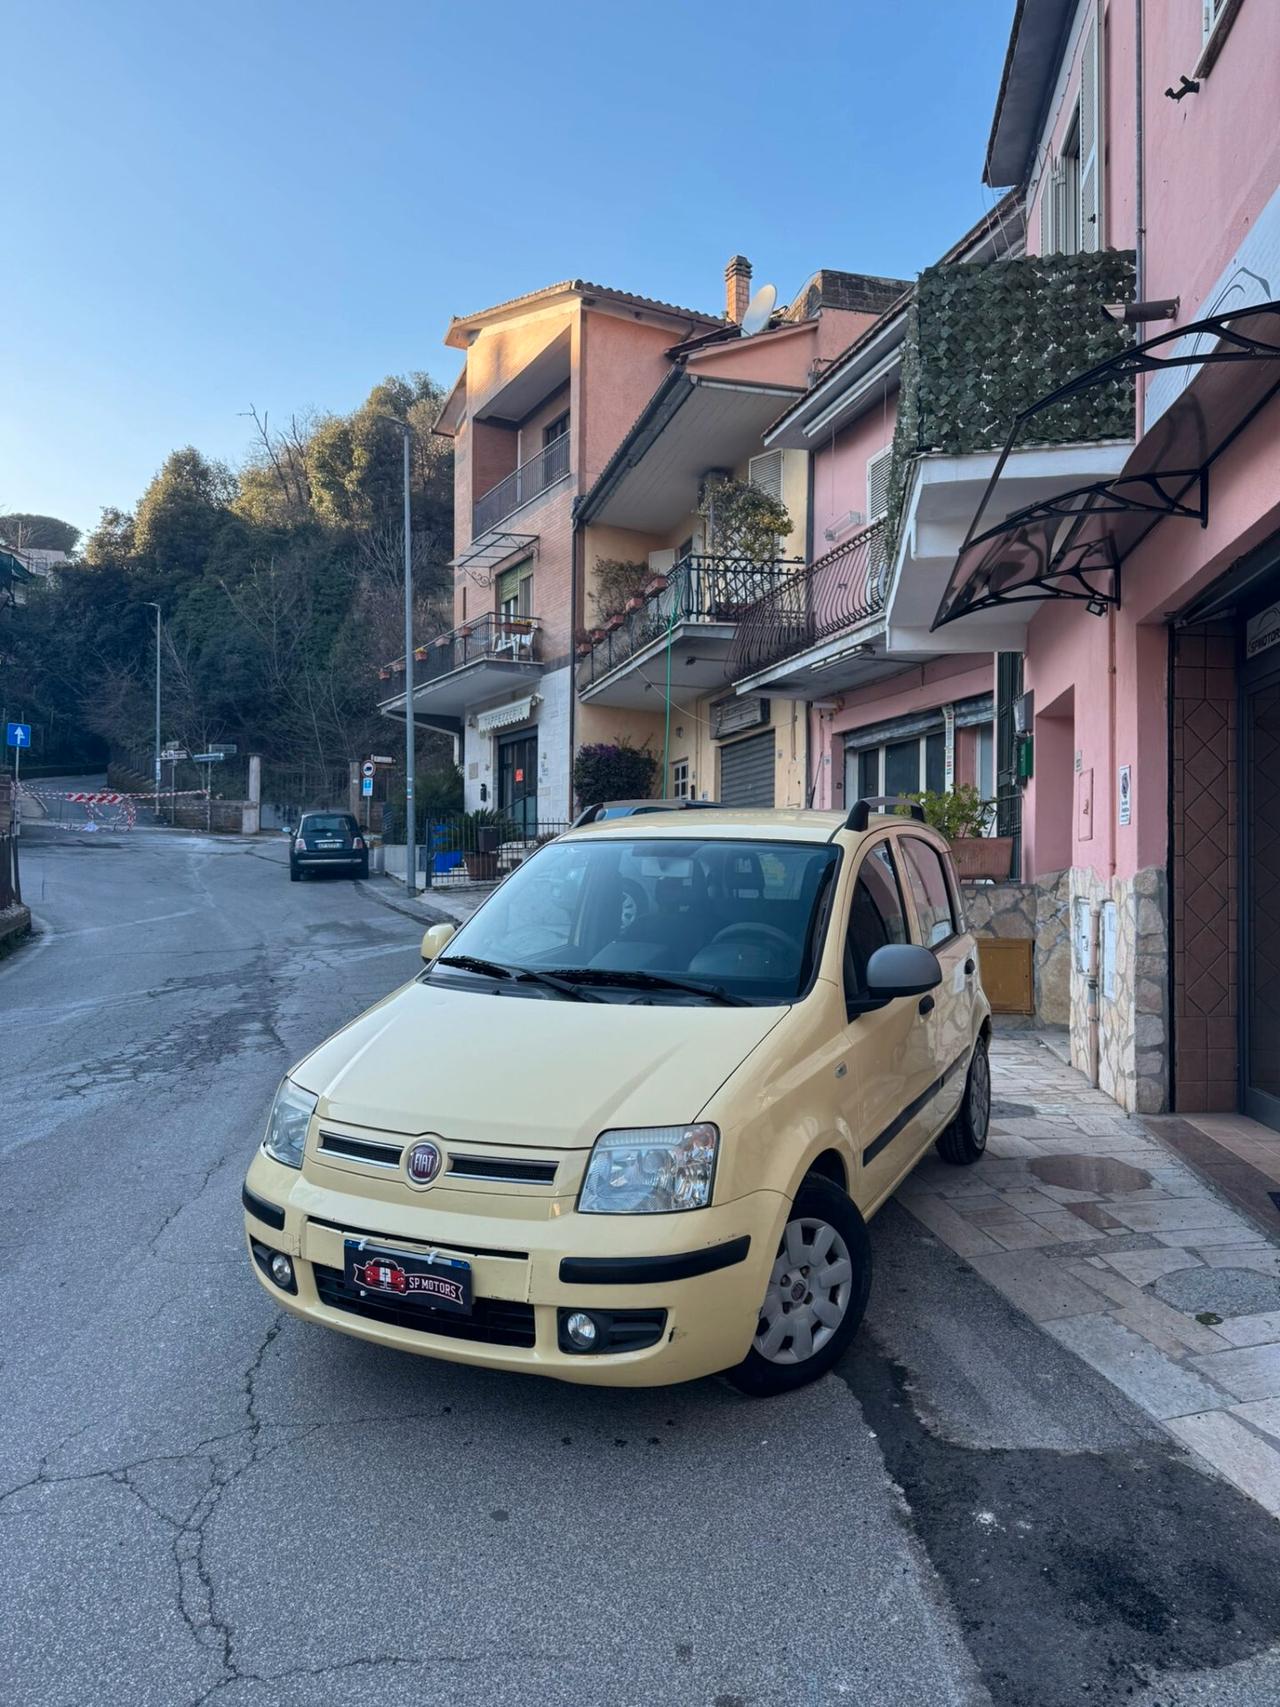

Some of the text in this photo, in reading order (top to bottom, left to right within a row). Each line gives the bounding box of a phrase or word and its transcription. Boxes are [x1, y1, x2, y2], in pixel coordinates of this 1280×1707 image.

[414, 1153, 434, 1172] FIAT
[409, 1276, 456, 1298] SP MOTORS
